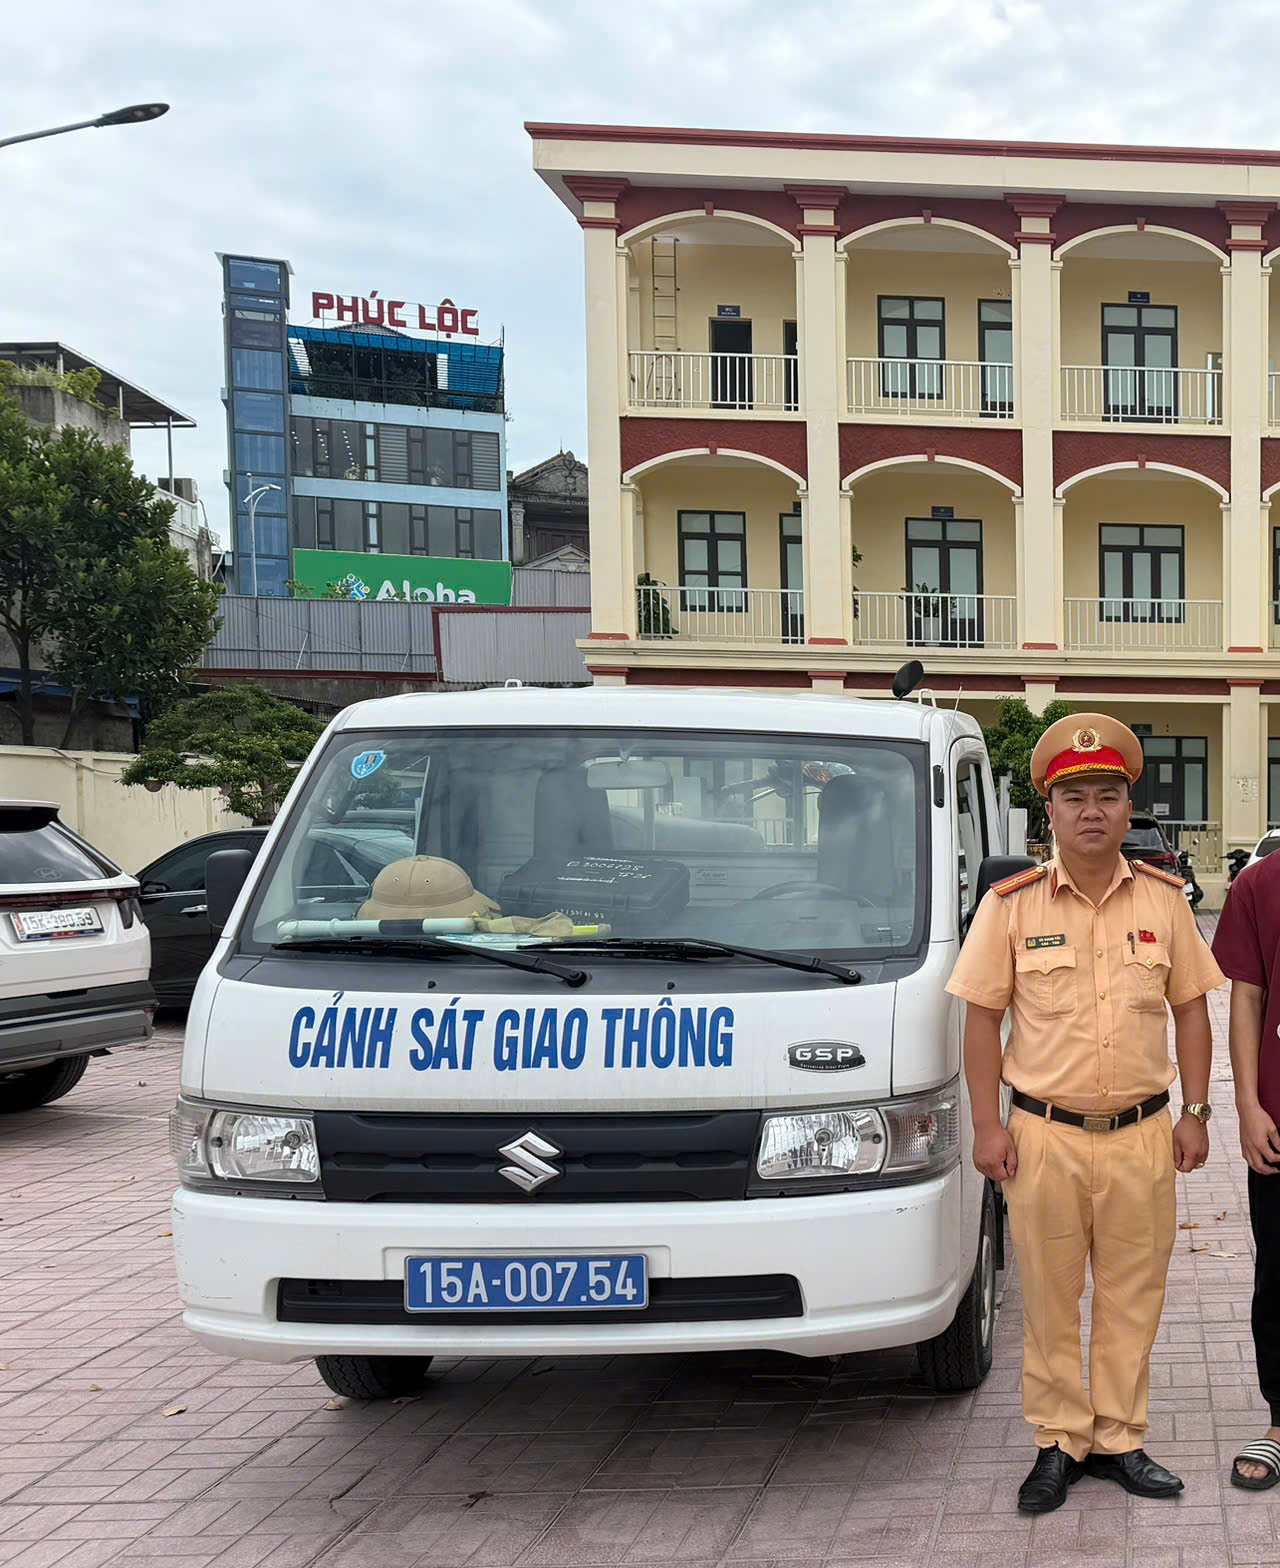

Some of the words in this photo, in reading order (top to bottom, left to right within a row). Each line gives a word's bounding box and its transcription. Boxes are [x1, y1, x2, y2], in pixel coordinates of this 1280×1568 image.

[312, 290, 407, 328] PHÚC
[418, 298, 480, 339] LỘC
[376, 580, 476, 604] Aloha
[288, 991, 399, 1069] CẢNH
[409, 997, 485, 1071] SÁT
[493, 1007, 588, 1071] GIAO
[601, 997, 735, 1069] THÔNG
[795, 1047, 854, 1062] GSP
[419, 1260, 638, 1304] 15A-007.54
